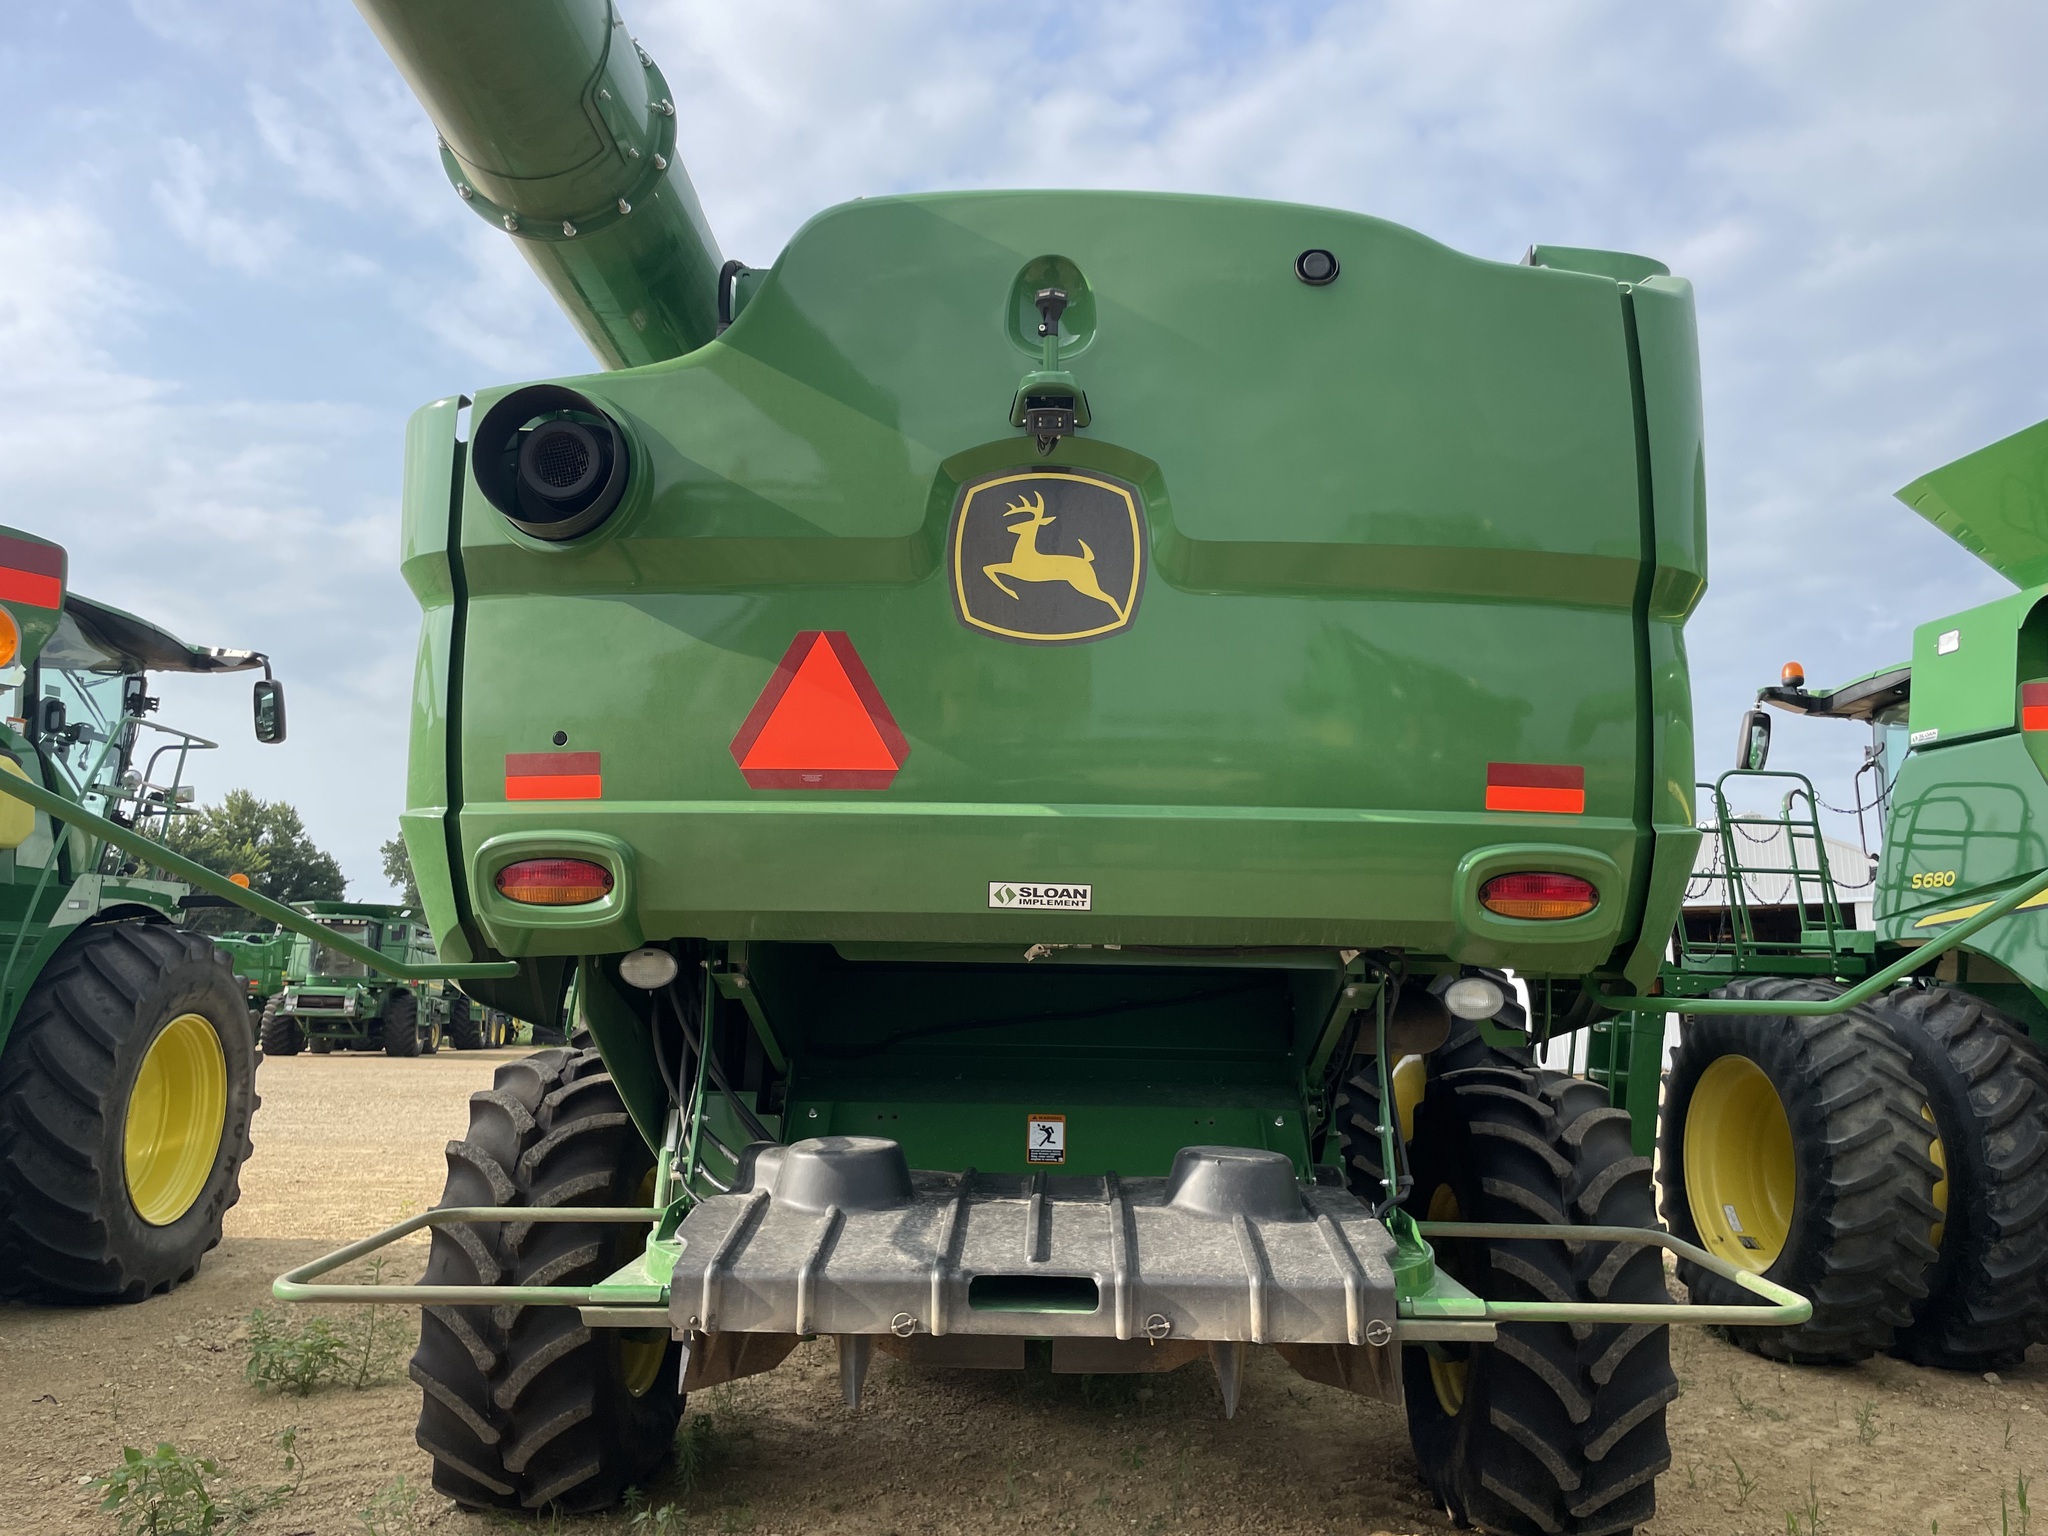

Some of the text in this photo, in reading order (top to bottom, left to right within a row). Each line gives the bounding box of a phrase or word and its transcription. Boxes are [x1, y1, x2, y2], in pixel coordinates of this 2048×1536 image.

[1911, 870, 1956, 889] S680
[1019, 887, 1087, 899] SLOAN
[1019, 898, 1087, 906] IMPLEMENT
